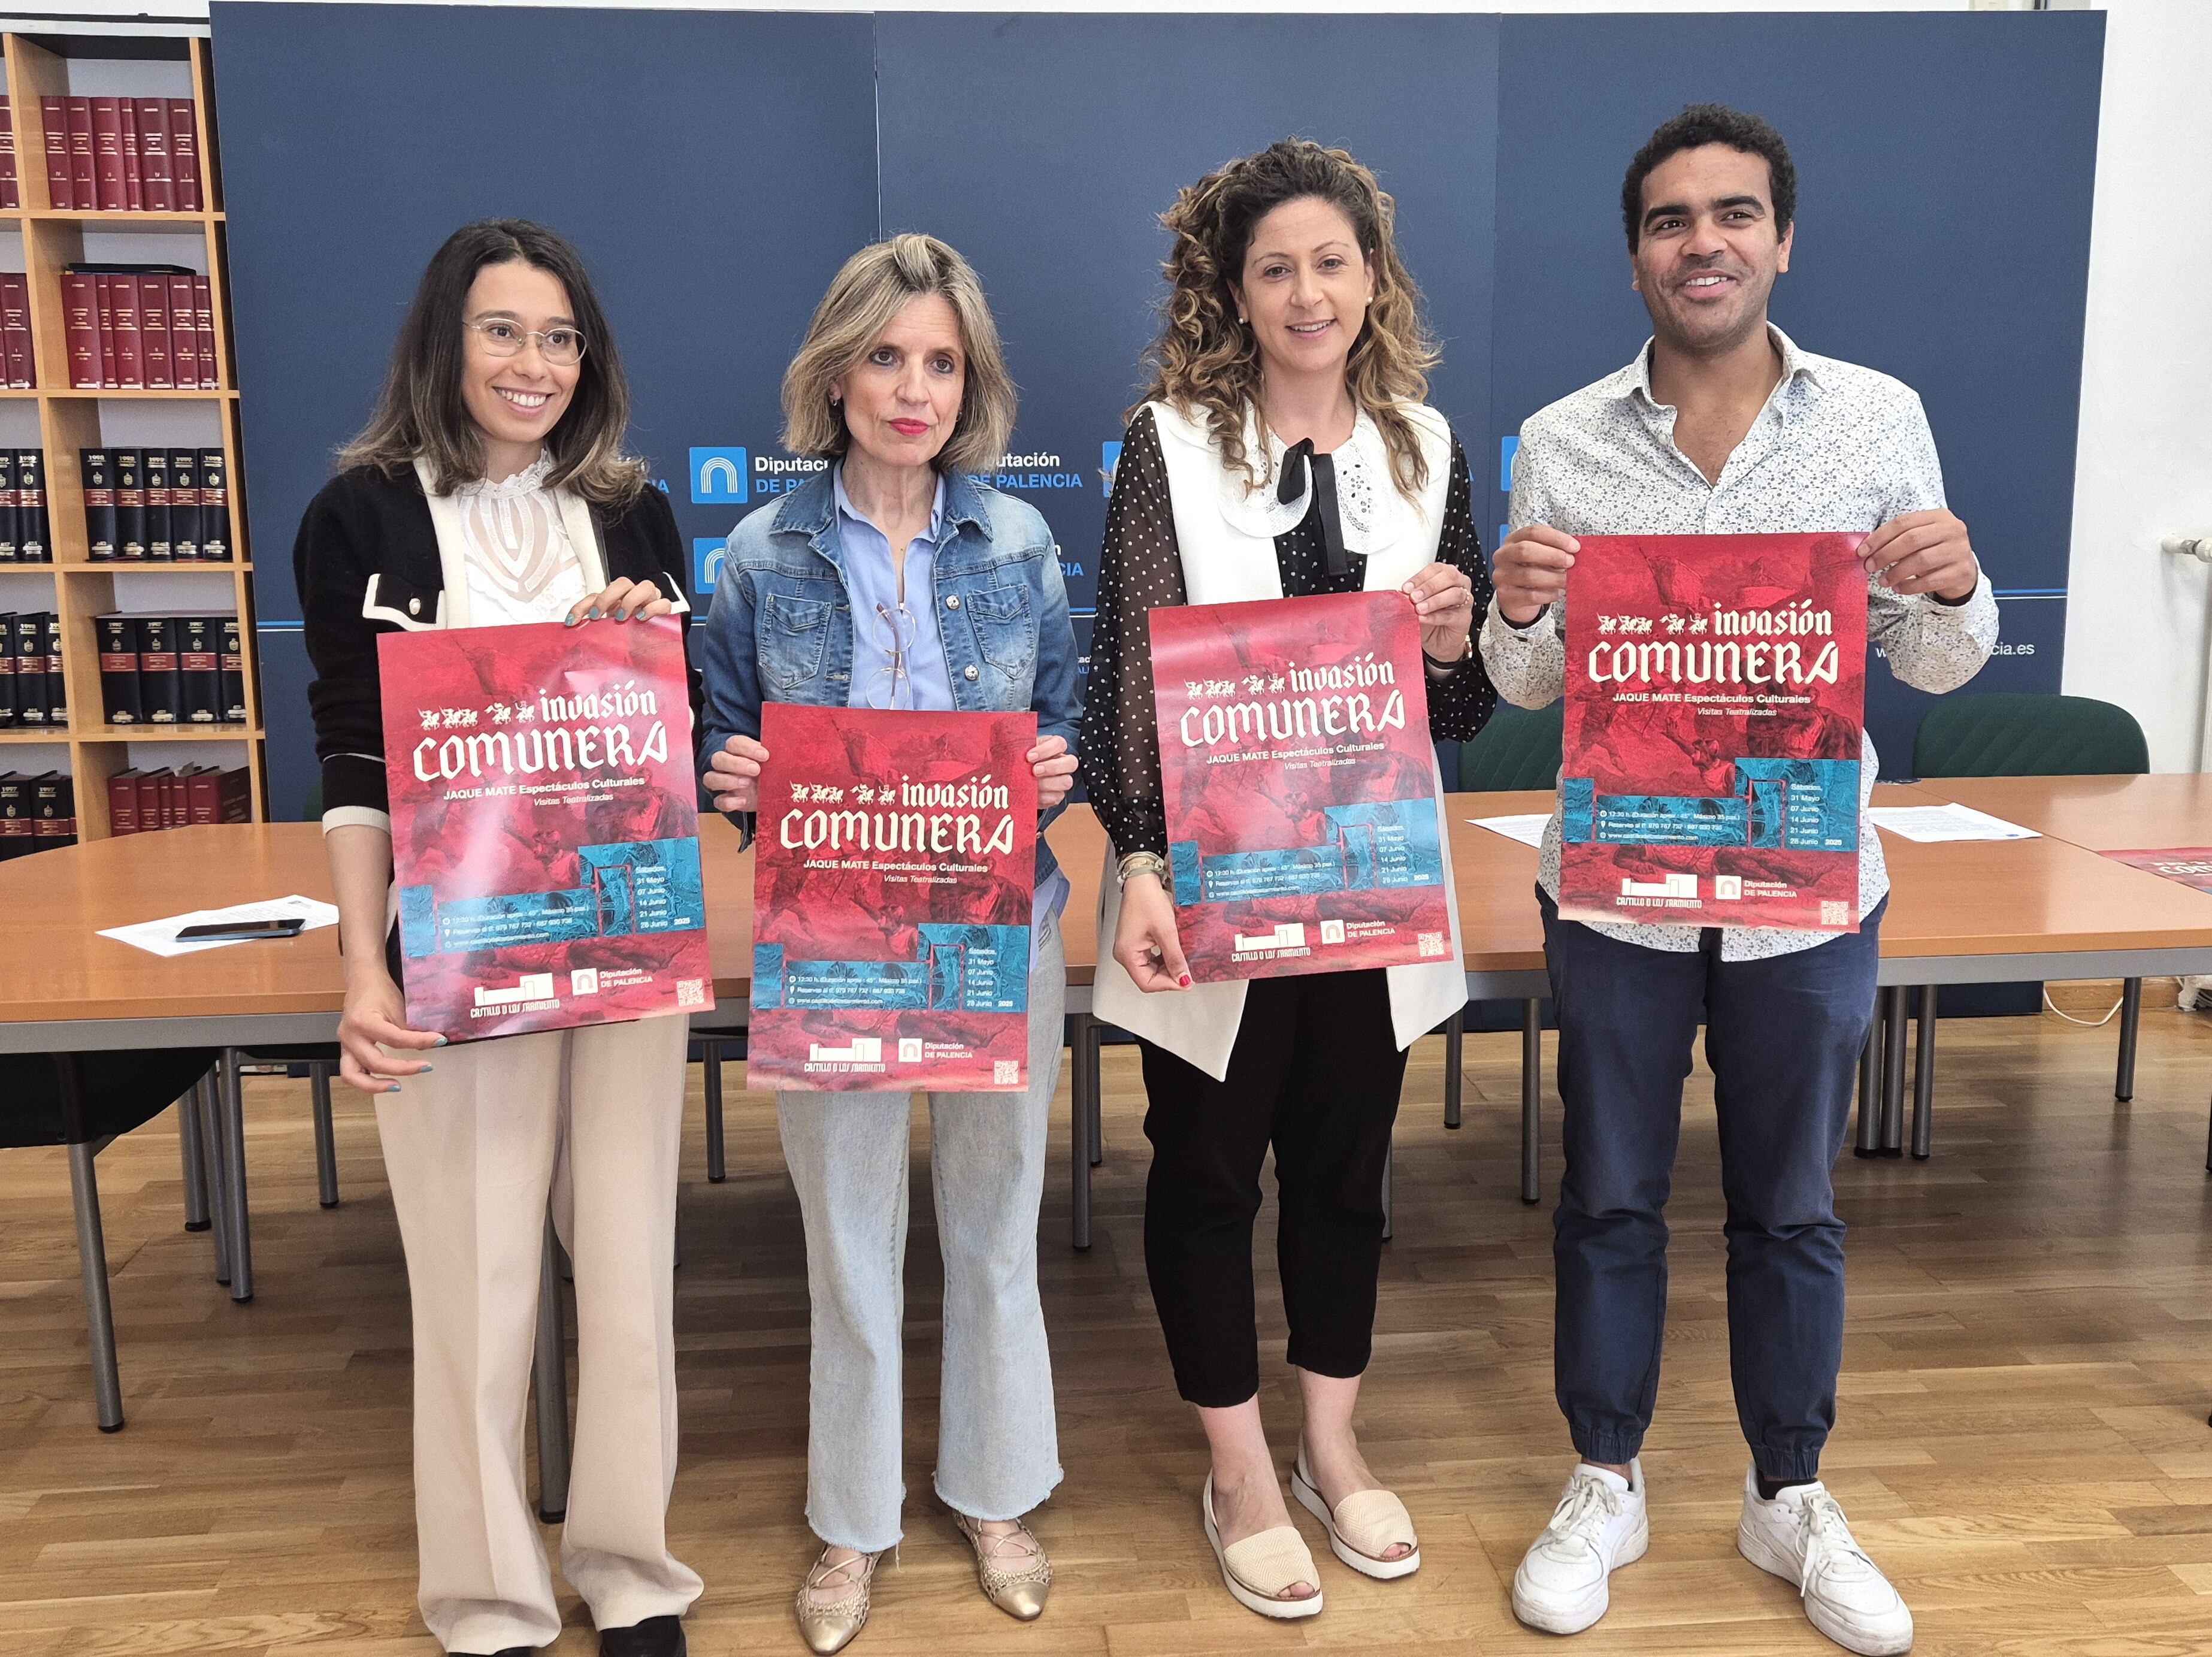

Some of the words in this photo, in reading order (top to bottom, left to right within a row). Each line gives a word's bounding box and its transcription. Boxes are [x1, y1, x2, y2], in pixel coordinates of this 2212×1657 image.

[755, 456, 828, 474] Diputac
[996, 452, 1060, 467] utación
[756, 479, 780, 492] DE
[996, 473, 1083, 488] PALENCIA
[1713, 598, 1833, 636] invasión
[1588, 639, 1838, 685] COMUNERA
[1287, 650, 1395, 693] invasión
[538, 678, 658, 723] invasión
[1612, 693, 1648, 701] JAQUE
[1652, 693, 1681, 701] MATE
[1684, 693, 1753, 705] Espectáculos
[1756, 694, 1811, 703] Culturales
[1178, 689, 1406, 747] COMUNERA
[411, 720, 668, 782] COMUNERA
[1206, 753, 1239, 764] JAQUE
[1242, 751, 1269, 760] MATE
[1271, 745, 1334, 760] Espectáculos
[1336, 741, 1385, 753] Culturales
[443, 788, 482, 800] JAQUE
[485, 785, 516, 796] MATE
[518, 779, 589, 796] Espectáculos
[591, 776, 645, 788] Culturales
[901, 771, 1009, 810] invasión
[780, 807, 1013, 855] COMUNERA
[803, 859, 838, 869] JAQUE
[841, 860, 870, 869] MATE
[872, 860, 936, 873] Espectáculos
[939, 863, 988, 872] Culturales
[1744, 880, 1787, 889] Diputación
[1757, 890, 1797, 898] PALENCIA
[1346, 920, 1385, 930] Diputación
[1359, 927, 1395, 937] PALENCIA
[600, 967, 643, 979] Diputación
[600, 979, 612, 988] DE
[613, 975, 653, 986] PALENCIA
